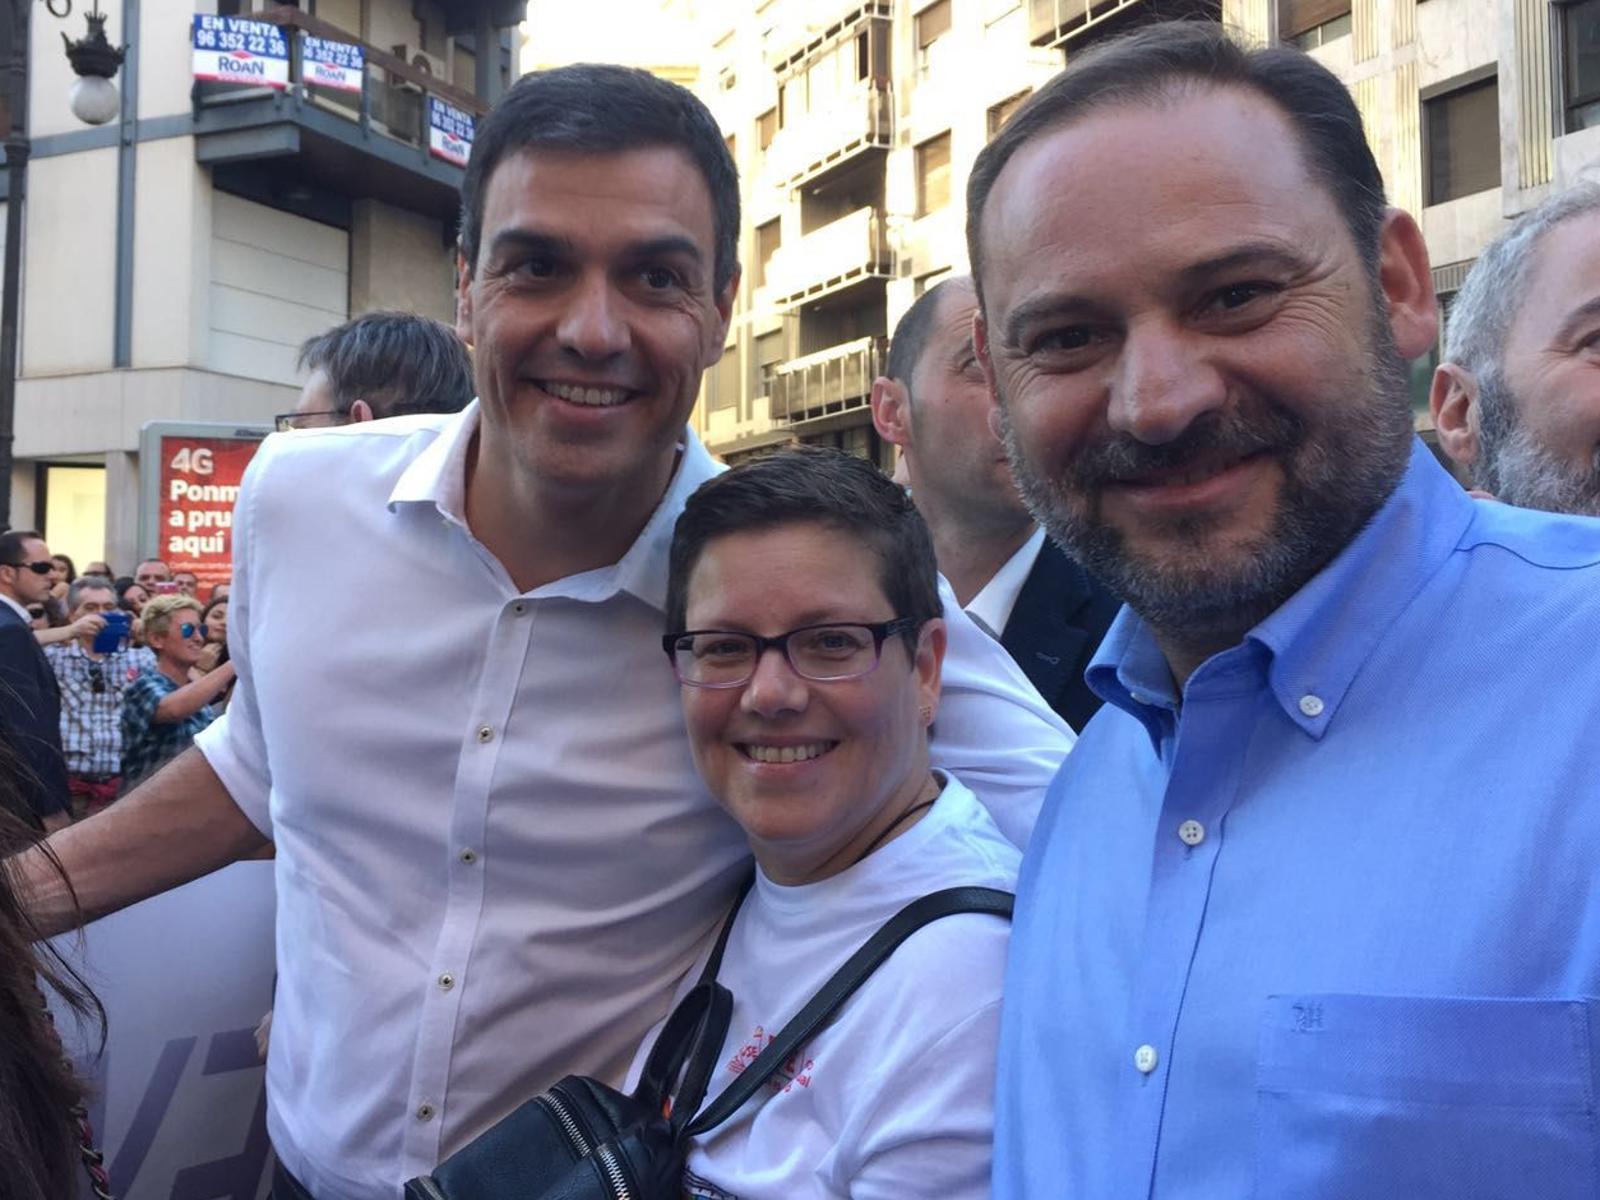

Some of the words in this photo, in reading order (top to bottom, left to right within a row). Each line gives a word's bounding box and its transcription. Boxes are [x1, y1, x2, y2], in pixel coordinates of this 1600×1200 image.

[202, 16, 224, 30] EN
[228, 18, 280, 38] VENTA
[197, 29, 216, 47] 96
[219, 32, 245, 50] 352
[248, 35, 266, 52] 22
[268, 38, 286, 56] 36
[305, 36, 320, 48] EN
[323, 40, 360, 57] VENTA
[447, 105, 473, 127] VENTA
[171, 447, 214, 475] 4G
[169, 509, 185, 527] a
[188, 510, 232, 532] pru
[169, 531, 225, 558] aquí
